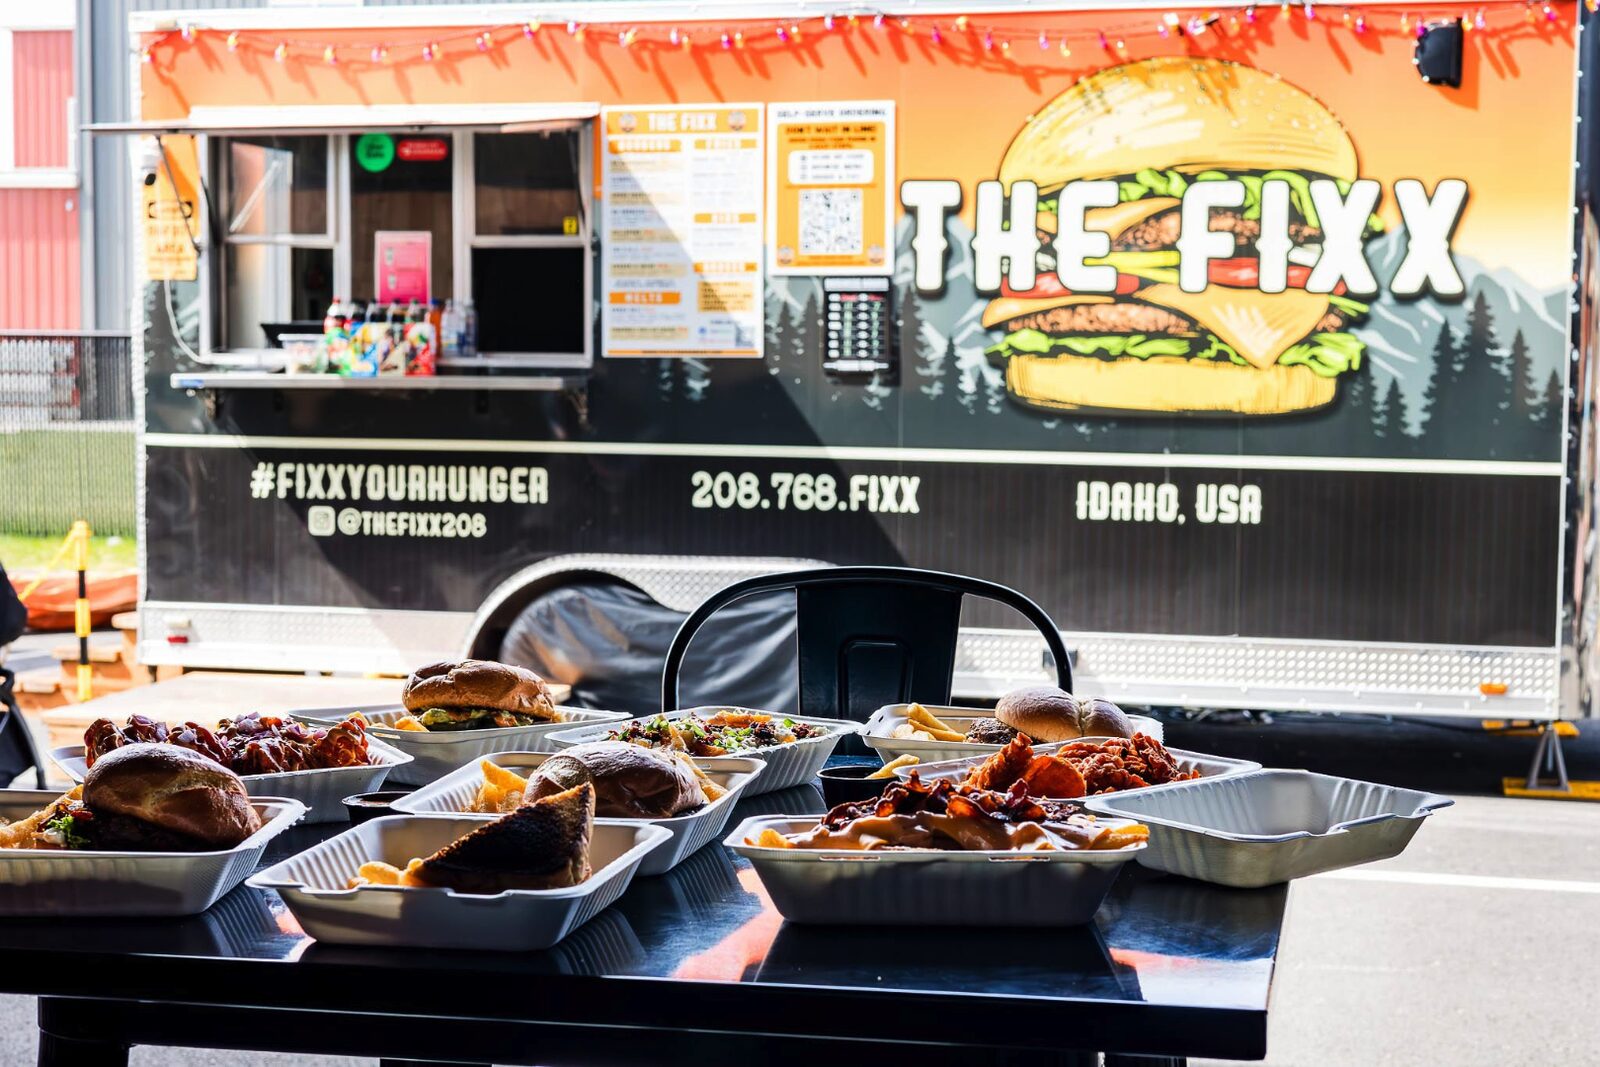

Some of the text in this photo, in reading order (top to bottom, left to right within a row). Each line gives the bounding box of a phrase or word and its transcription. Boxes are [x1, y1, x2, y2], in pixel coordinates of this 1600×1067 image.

[648, 111, 718, 131] THE FIXX
[900, 179, 1469, 297] THE FIXX
[250, 461, 549, 504] #FIXXYOURHUNGER
[691, 470, 921, 514] 208.768.FIXX
[1075, 480, 1263, 525] IDAHO, USA
[337, 506, 488, 538] @THEFIXX208
